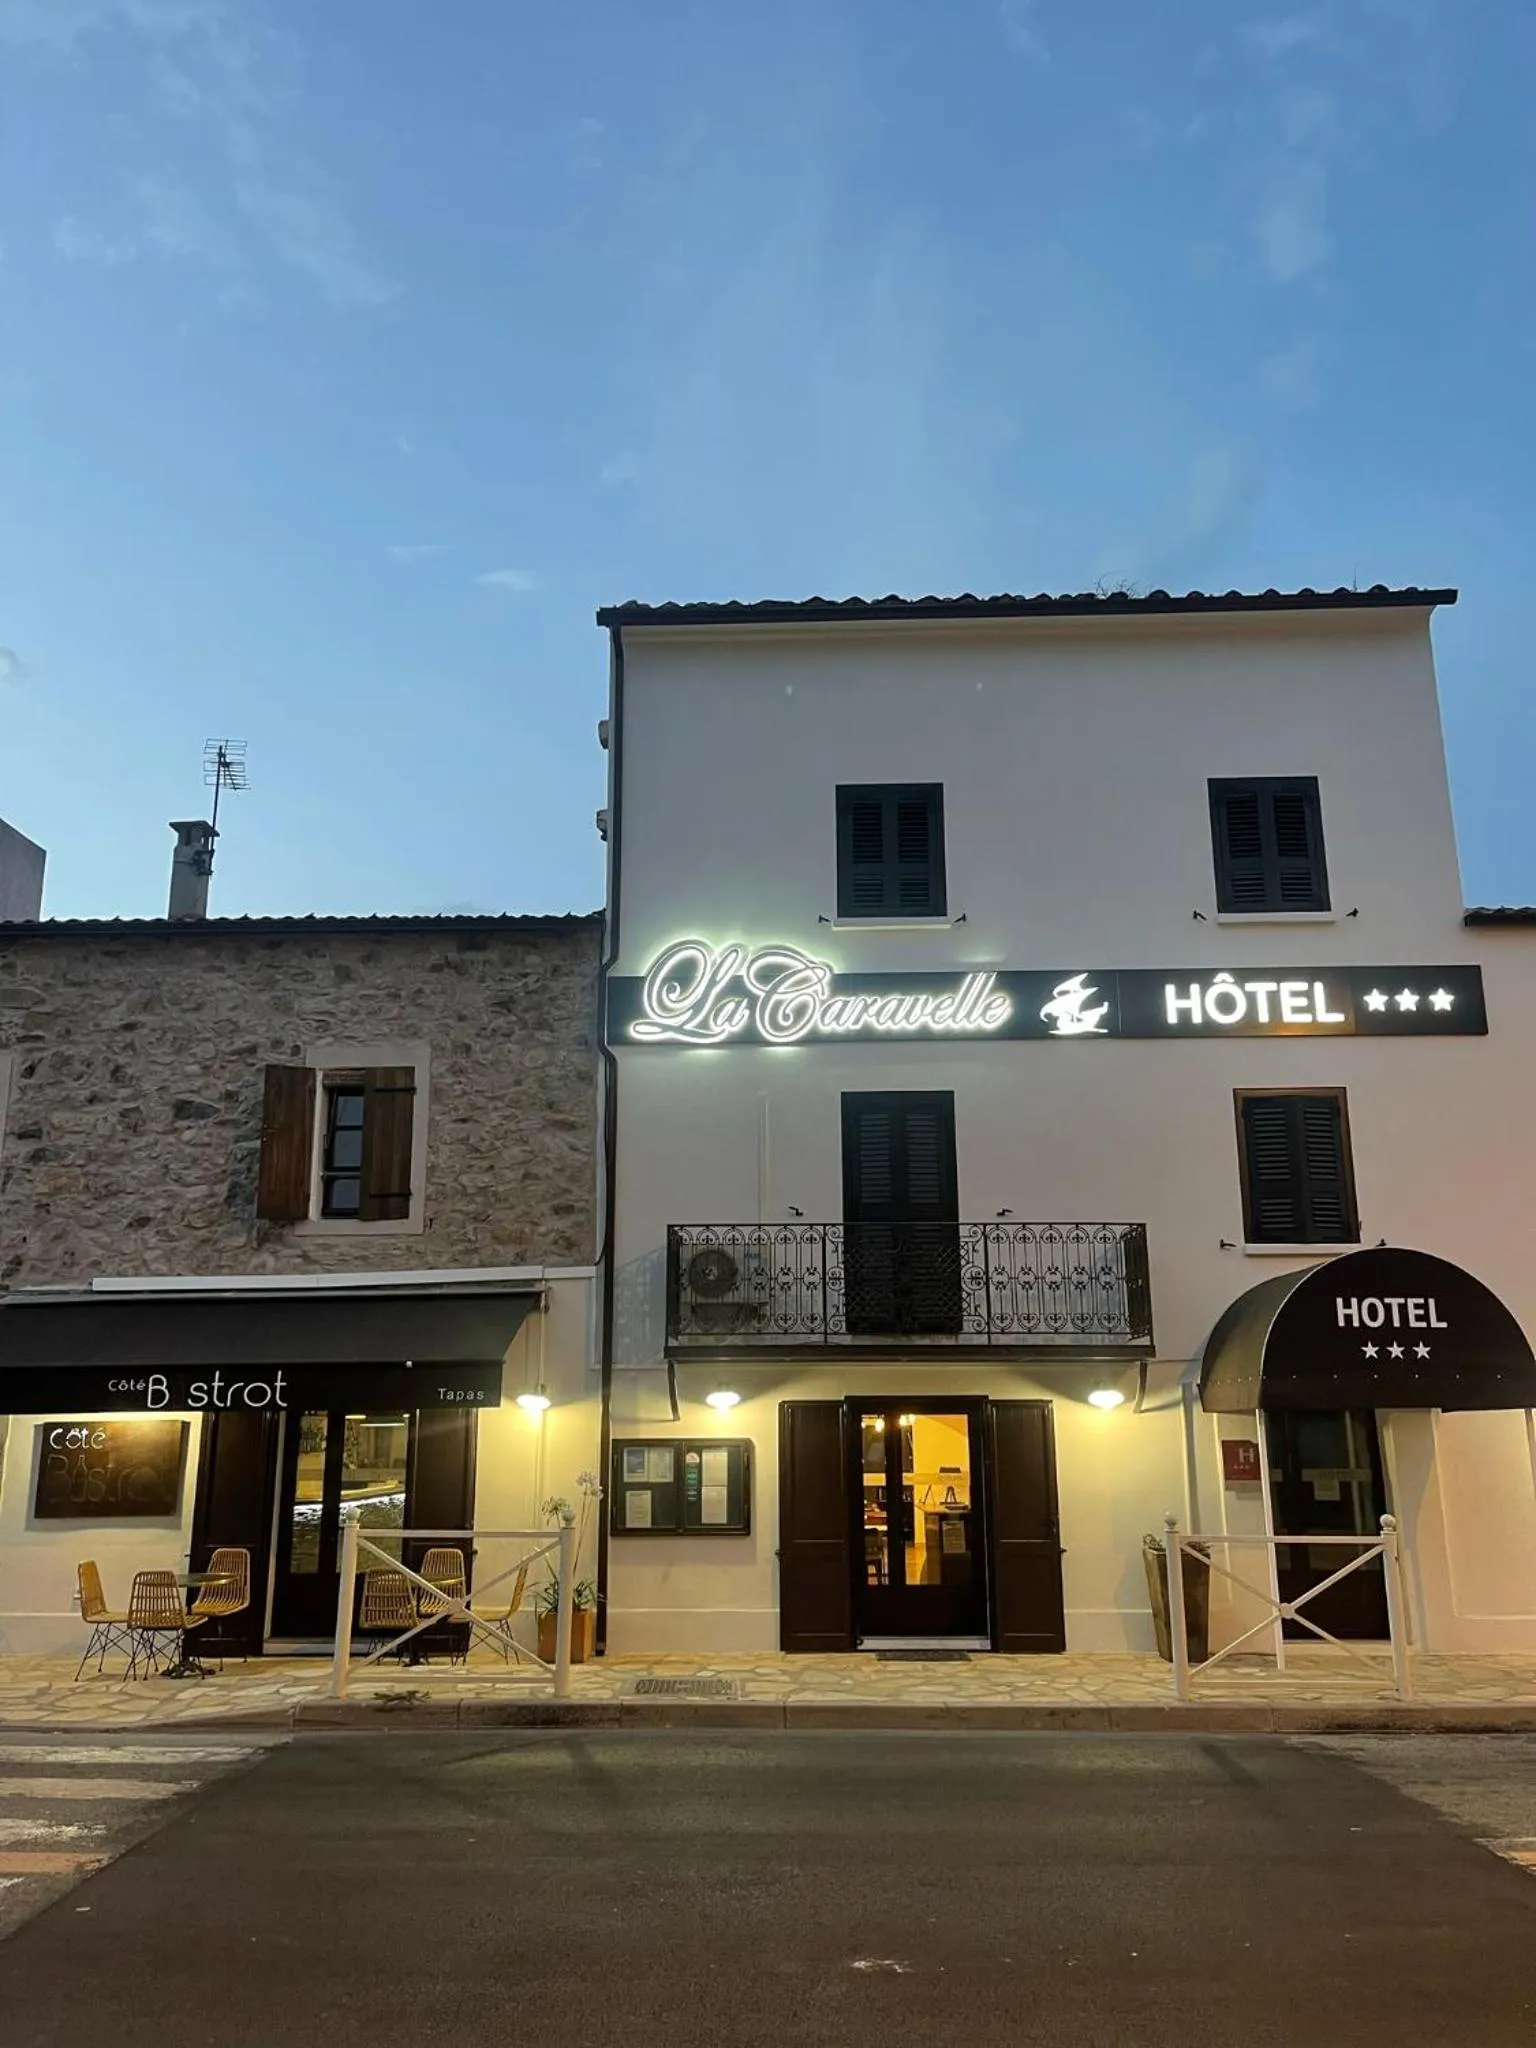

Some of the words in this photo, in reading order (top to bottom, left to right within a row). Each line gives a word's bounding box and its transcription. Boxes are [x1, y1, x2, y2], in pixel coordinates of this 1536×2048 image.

[631, 938, 750, 1044] La
[744, 944, 1013, 1043] Caravelle
[1163, 972, 1346, 1025] HÔTEL
[1336, 1297, 1448, 1329] HOTEL
[437, 1387, 485, 1402] Tapas
